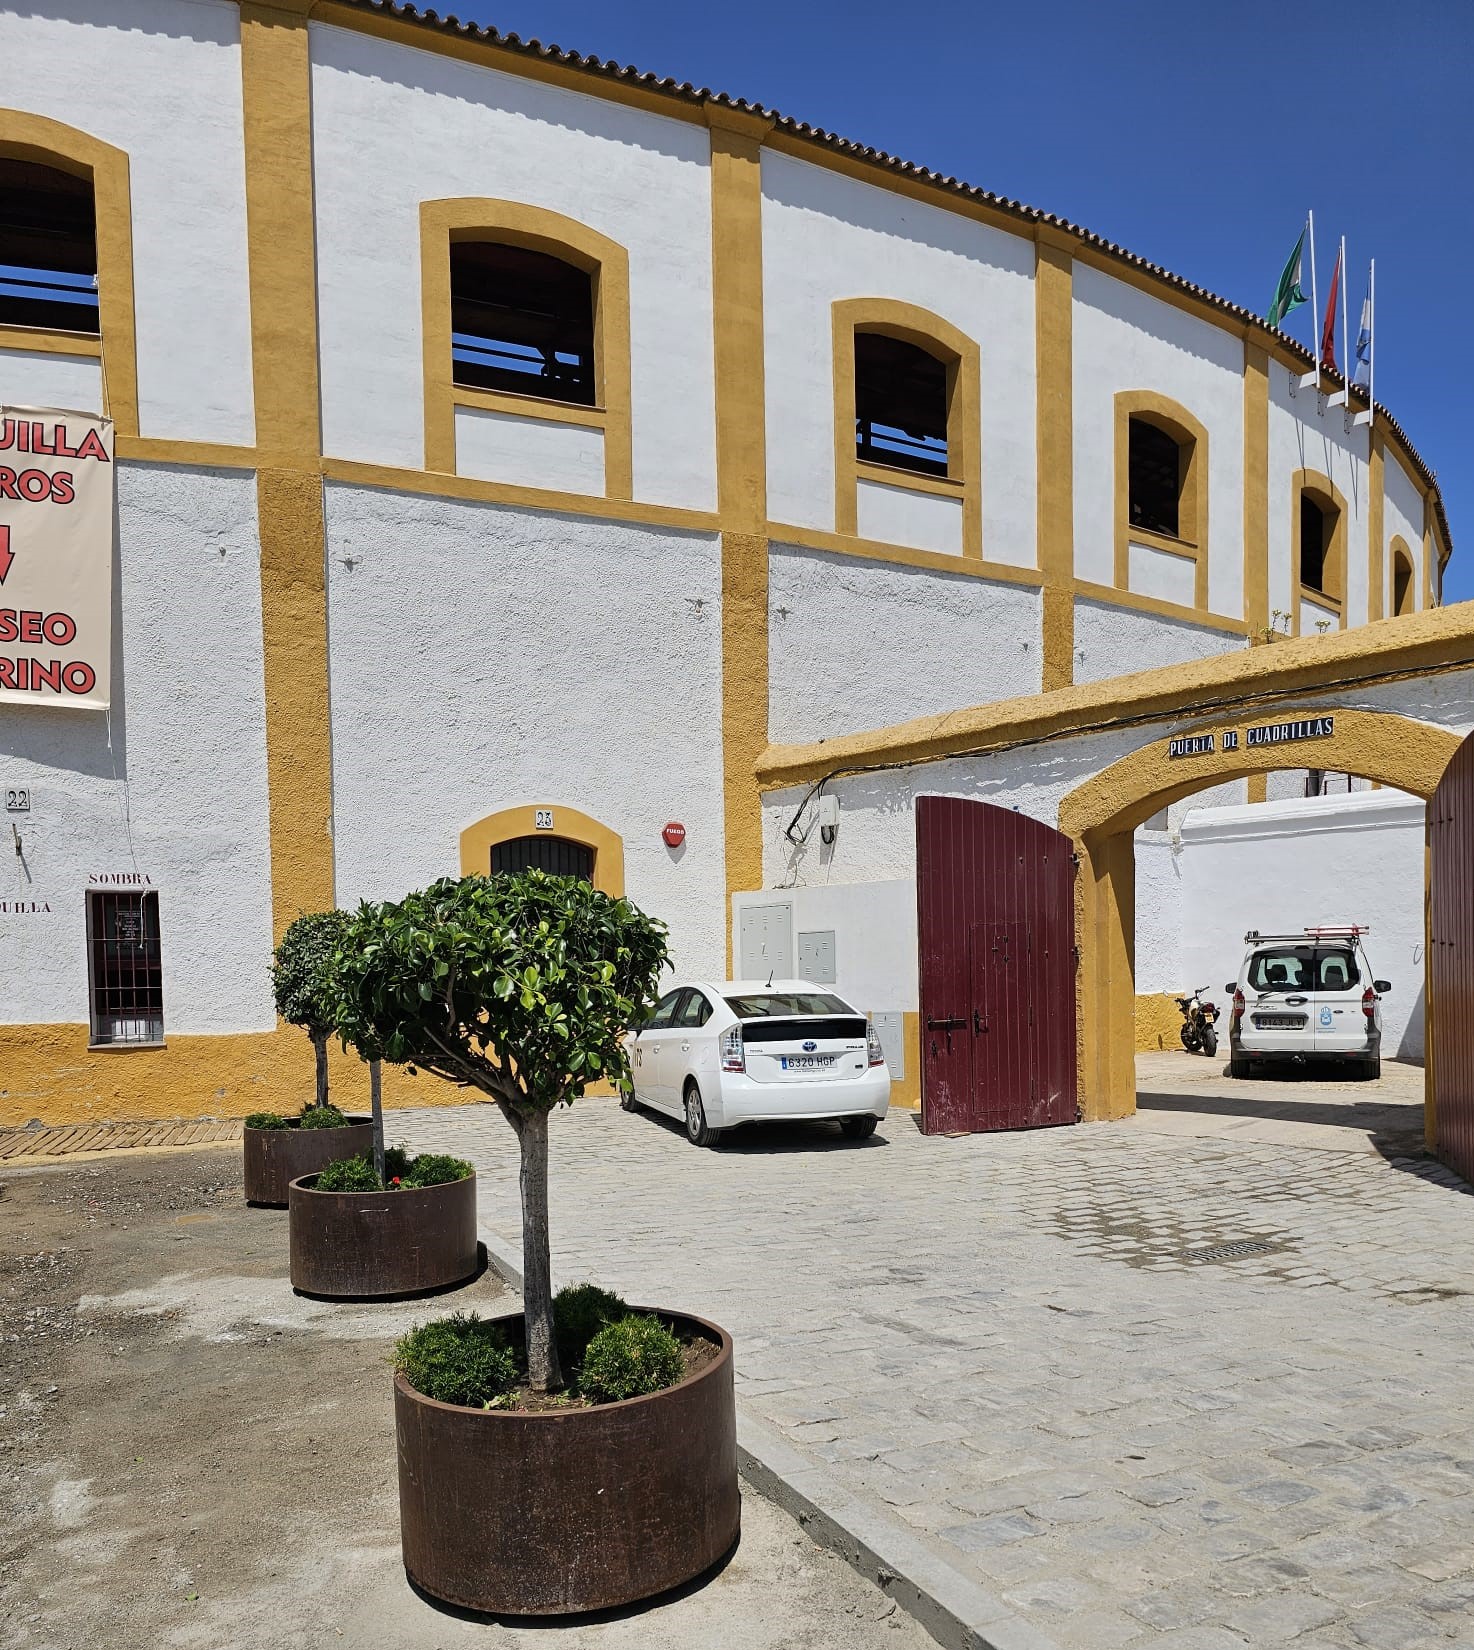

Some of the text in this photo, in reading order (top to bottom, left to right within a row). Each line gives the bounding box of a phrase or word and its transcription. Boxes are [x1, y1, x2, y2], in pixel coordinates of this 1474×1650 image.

[0, 466, 75, 504] ROS
[0, 608, 77, 646] SEO
[0, 657, 96, 695] RINO
[1170, 718, 1333, 756] PUERTA DE CUADRILLAS
[7, 789, 28, 808] 22
[537, 811, 552, 827] 23
[88, 873, 152, 885] SOMBRA
[0, 901, 52, 914] UILLA
[788, 1056, 835, 1068] 6320 HGP
